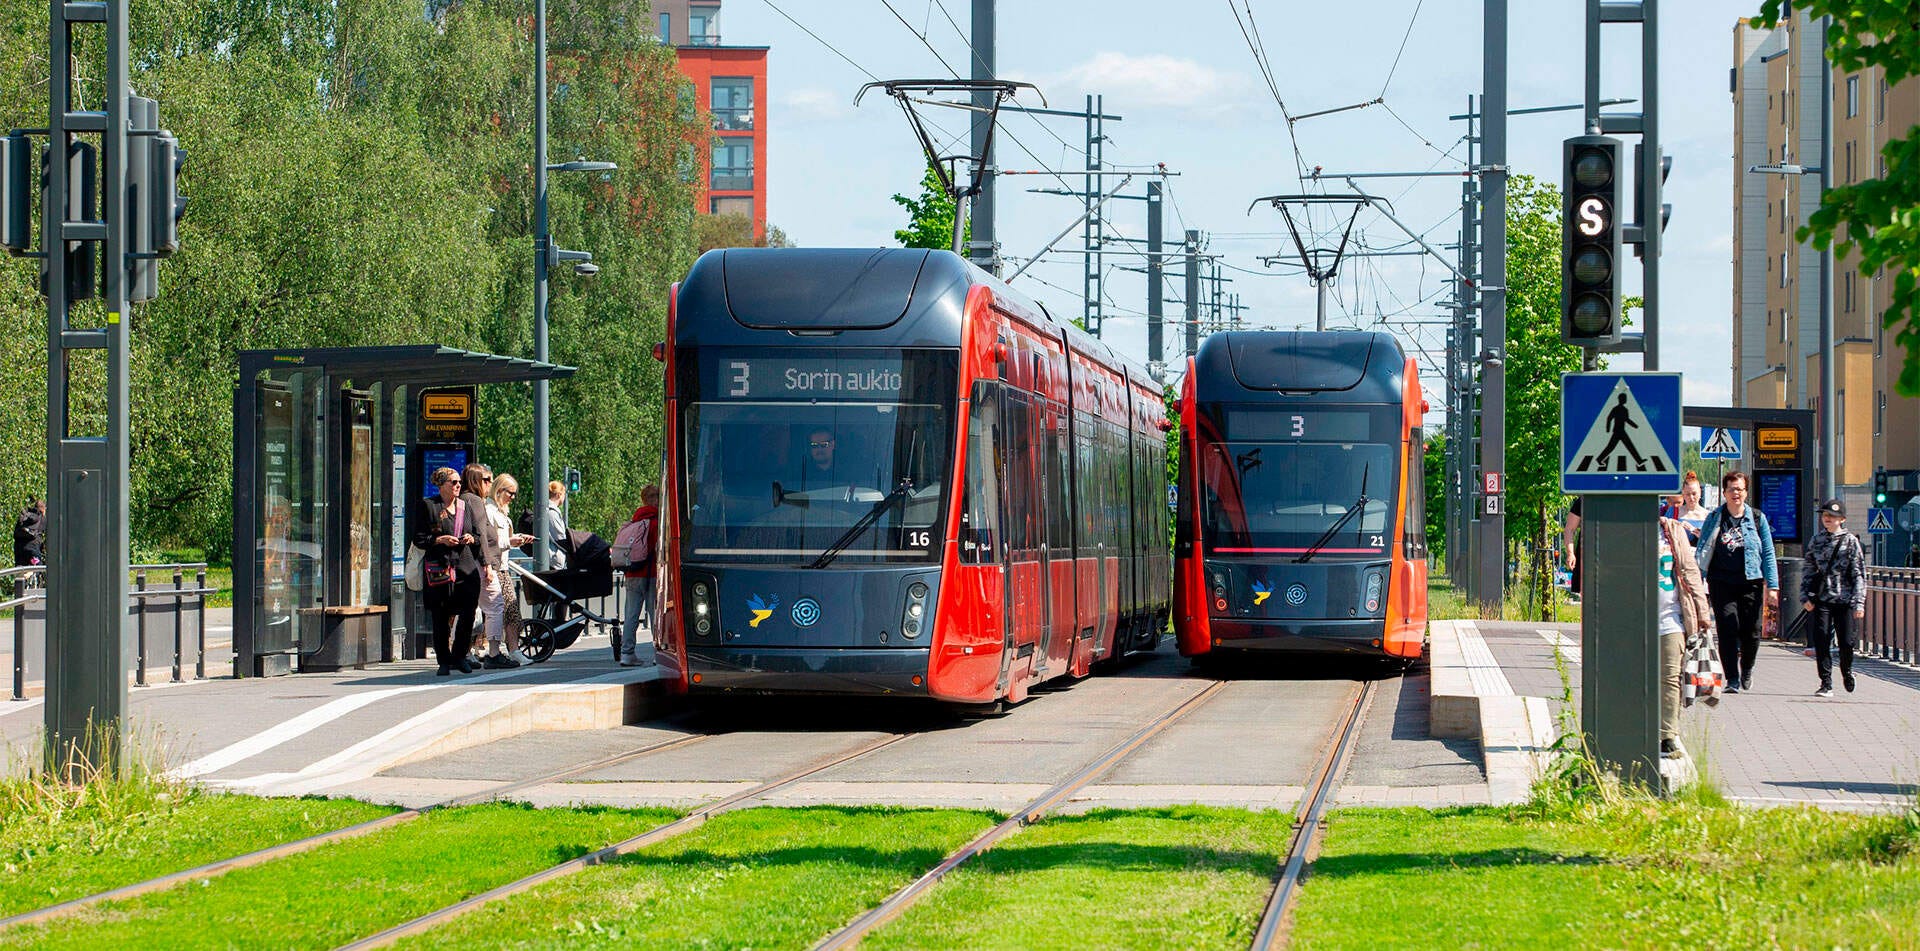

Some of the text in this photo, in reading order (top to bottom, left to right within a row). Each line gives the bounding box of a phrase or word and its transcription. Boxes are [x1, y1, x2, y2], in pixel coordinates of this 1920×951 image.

[1580, 199, 1603, 235] S
[730, 361, 902, 397] 3 Sorin aukio
[1291, 415, 1304, 437] 3
[1488, 479, 1495, 489] 2
[1488, 500, 1496, 511] 4
[909, 531, 930, 547] 16
[1370, 535, 1385, 547] 21
